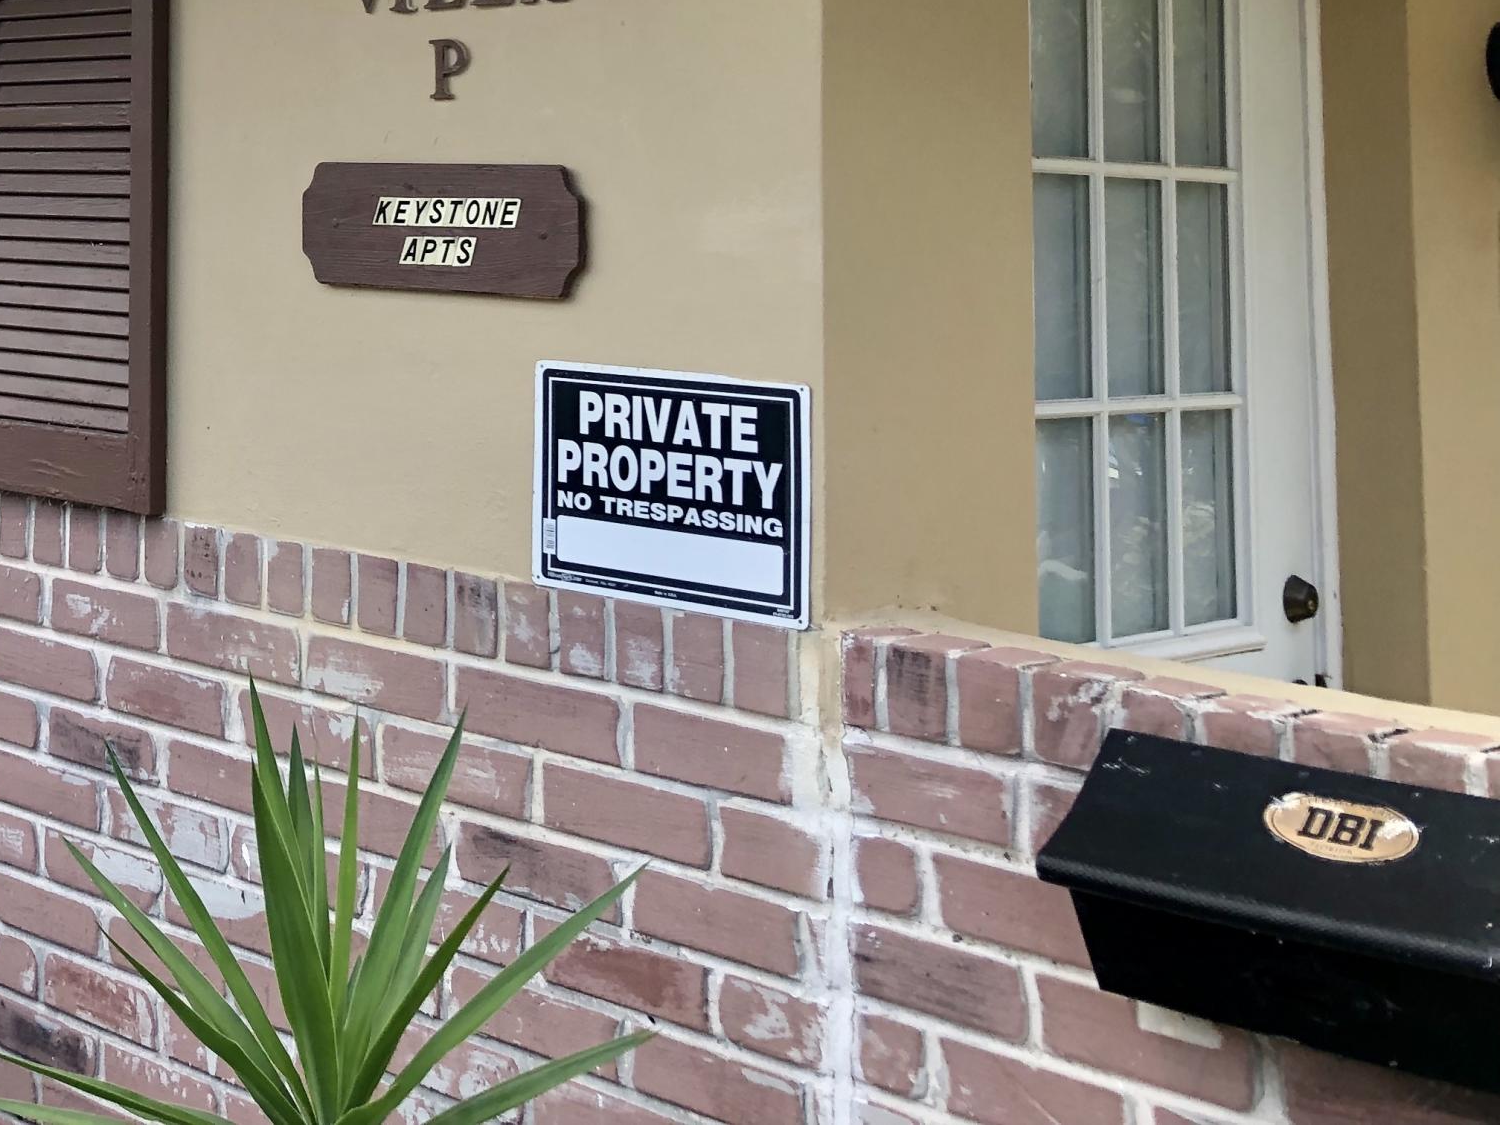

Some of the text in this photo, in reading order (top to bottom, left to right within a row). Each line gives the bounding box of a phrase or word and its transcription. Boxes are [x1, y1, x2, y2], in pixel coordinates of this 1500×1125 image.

[429, 39, 472, 100] P
[374, 199, 518, 226] KEYSTONE
[402, 237, 475, 264] APTS
[579, 390, 759, 453] PRIVATE
[557, 439, 783, 510] PROPERTY
[557, 490, 784, 538] NO TRESPASSING
[1297, 806, 1384, 851] DBI
